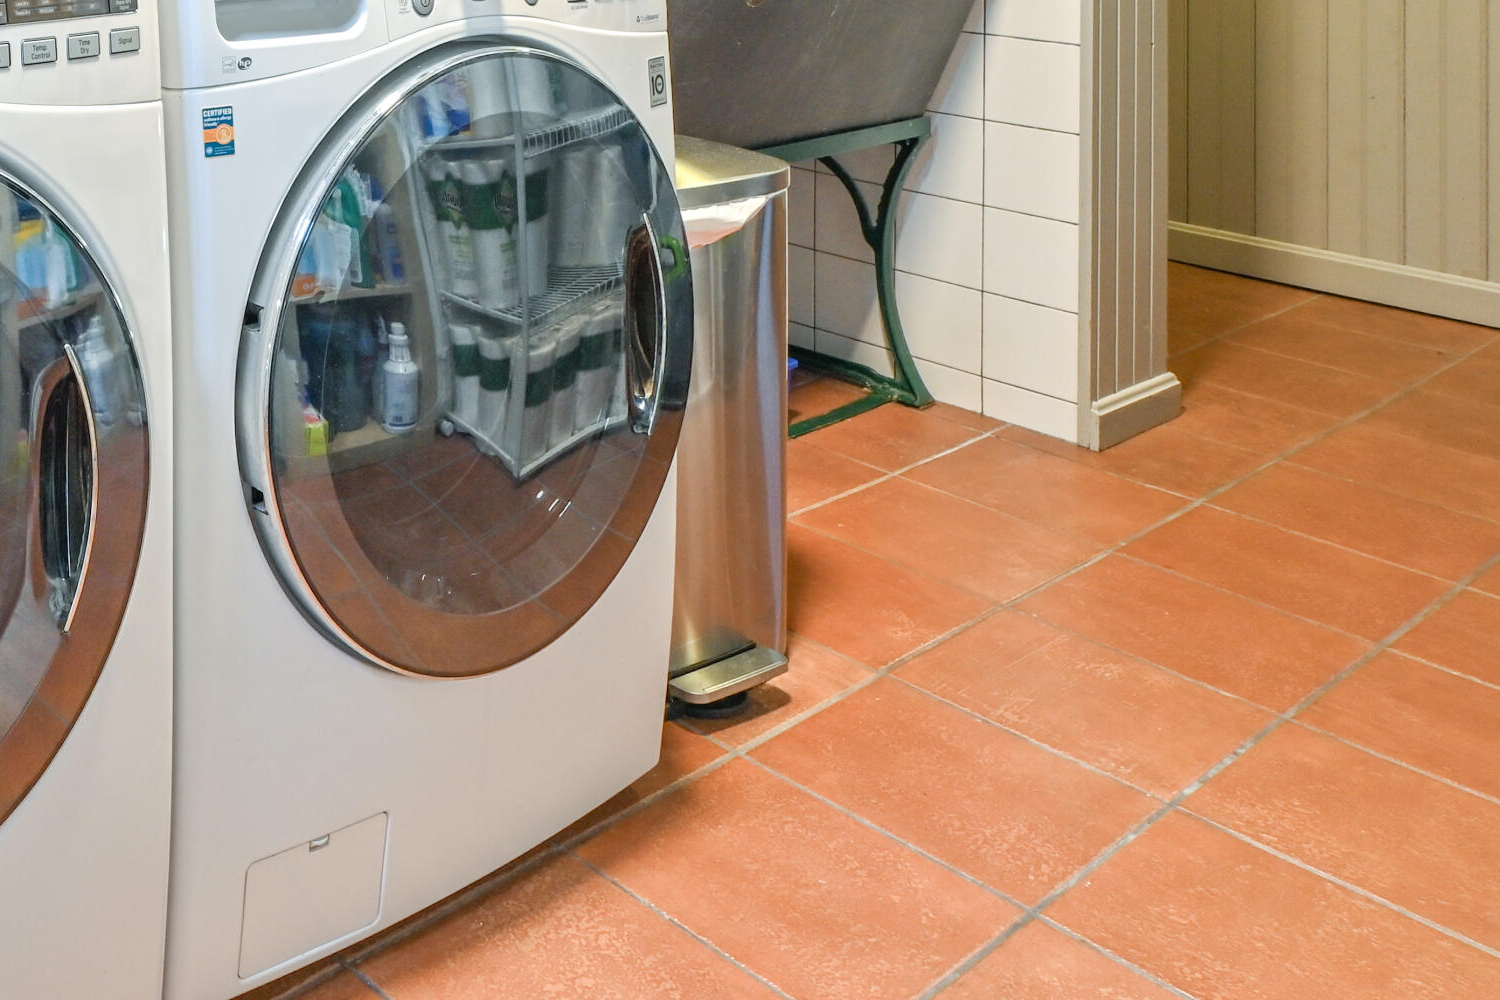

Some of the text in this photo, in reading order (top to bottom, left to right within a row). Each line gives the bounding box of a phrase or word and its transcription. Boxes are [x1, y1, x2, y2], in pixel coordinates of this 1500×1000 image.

[118, 36, 133, 46] Signal
[81, 46, 90, 55] Dry
[31, 51, 51, 61] Control
[651, 73, 665, 97] 10
[203, 108, 232, 117] CERTIFIED
